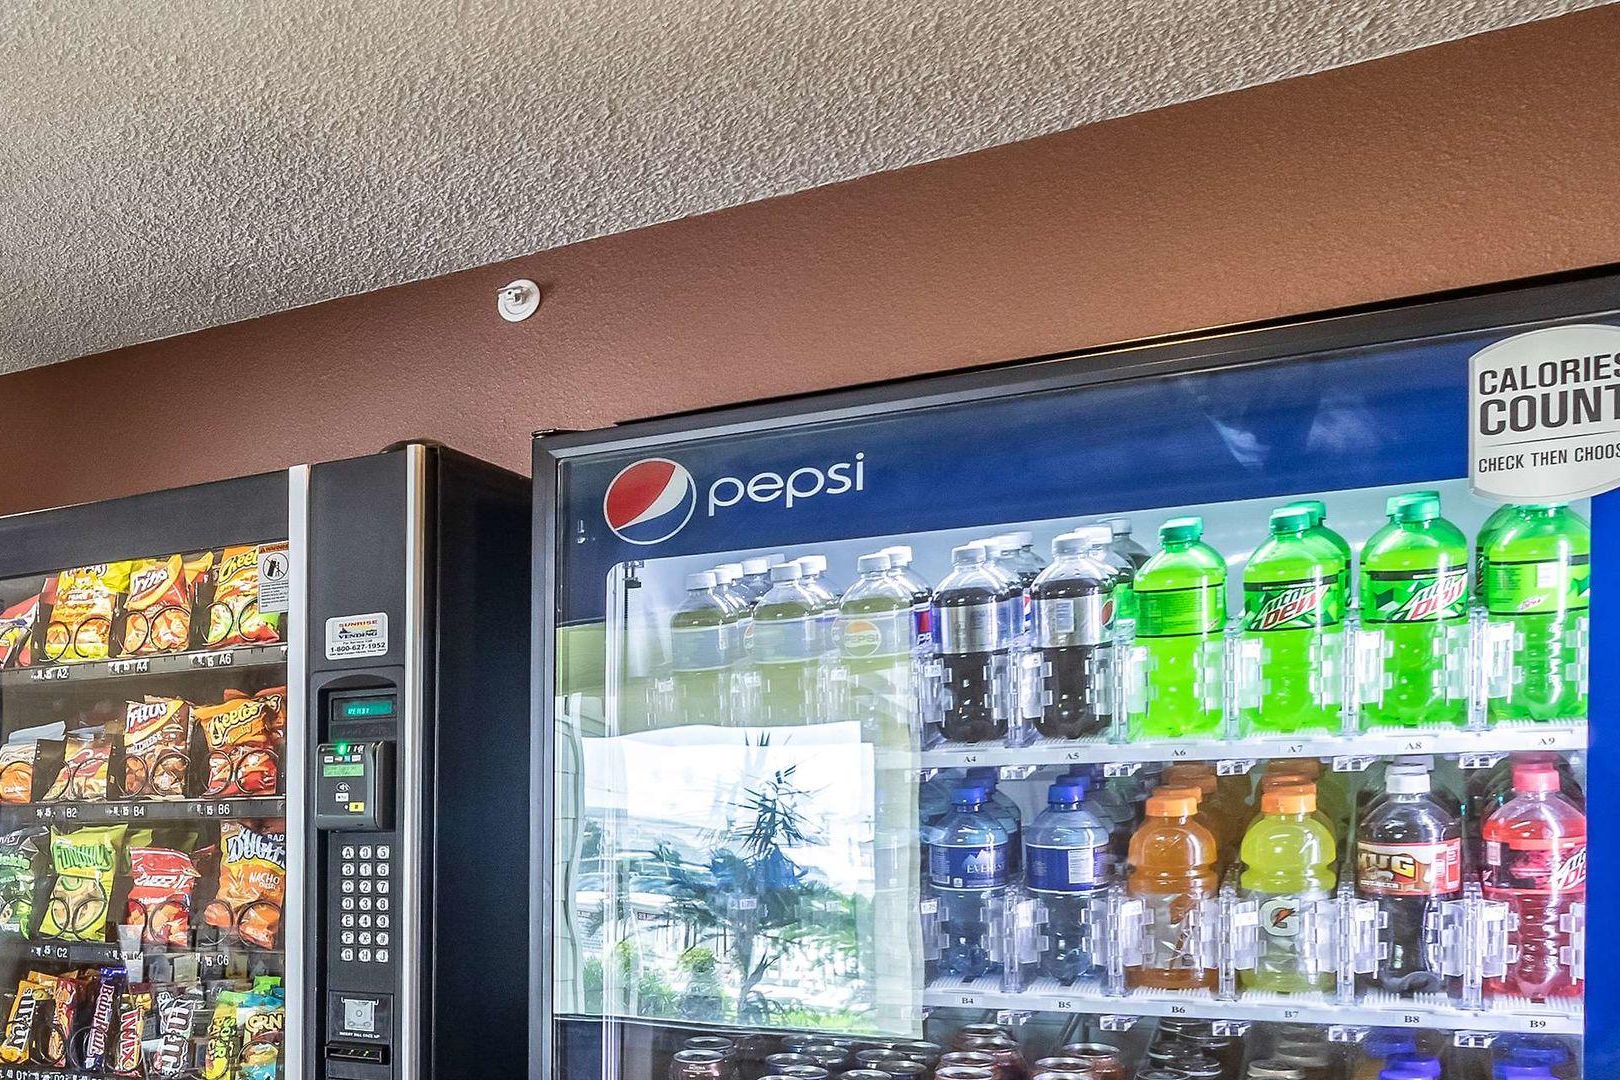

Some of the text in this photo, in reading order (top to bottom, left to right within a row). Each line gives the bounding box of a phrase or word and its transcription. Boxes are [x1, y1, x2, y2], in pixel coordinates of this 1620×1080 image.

[1478, 453, 1524, 473] CHECK
[1531, 449, 1567, 467] THEN
[709, 452, 865, 517] pepsi
[339, 620, 378, 628] SUNRISE
[218, 652, 231, 665] A6
[216, 954, 229, 965] C6
